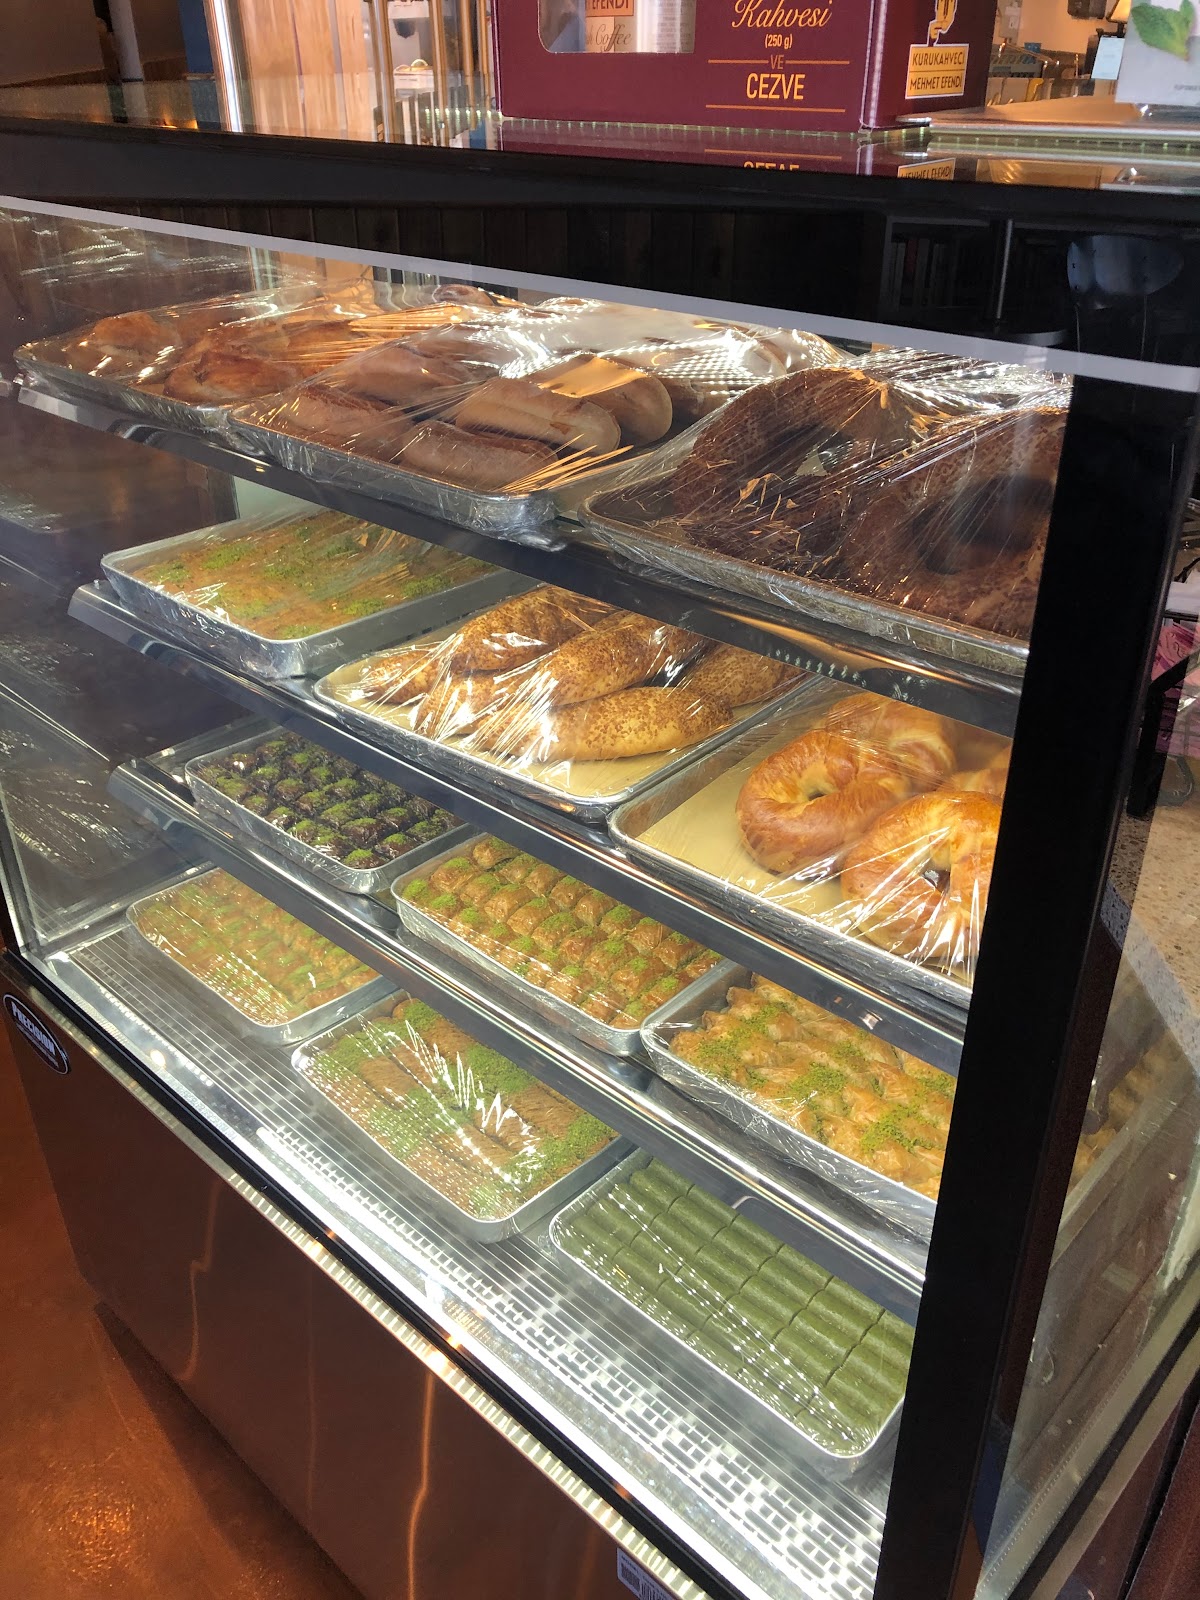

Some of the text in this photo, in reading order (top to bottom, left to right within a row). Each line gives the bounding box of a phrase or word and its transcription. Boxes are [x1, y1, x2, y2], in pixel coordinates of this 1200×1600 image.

[731, 0, 833, 28] Kahvesi
[596, 24, 632, 52] Coffee
[764, 33, 793, 50] (250 g)
[770, 54, 785, 70] VE
[746, 72, 806, 100] CEZVE
[909, 76, 940, 91] MEHMET
[11, 1001, 56, 1056] PRECISION
